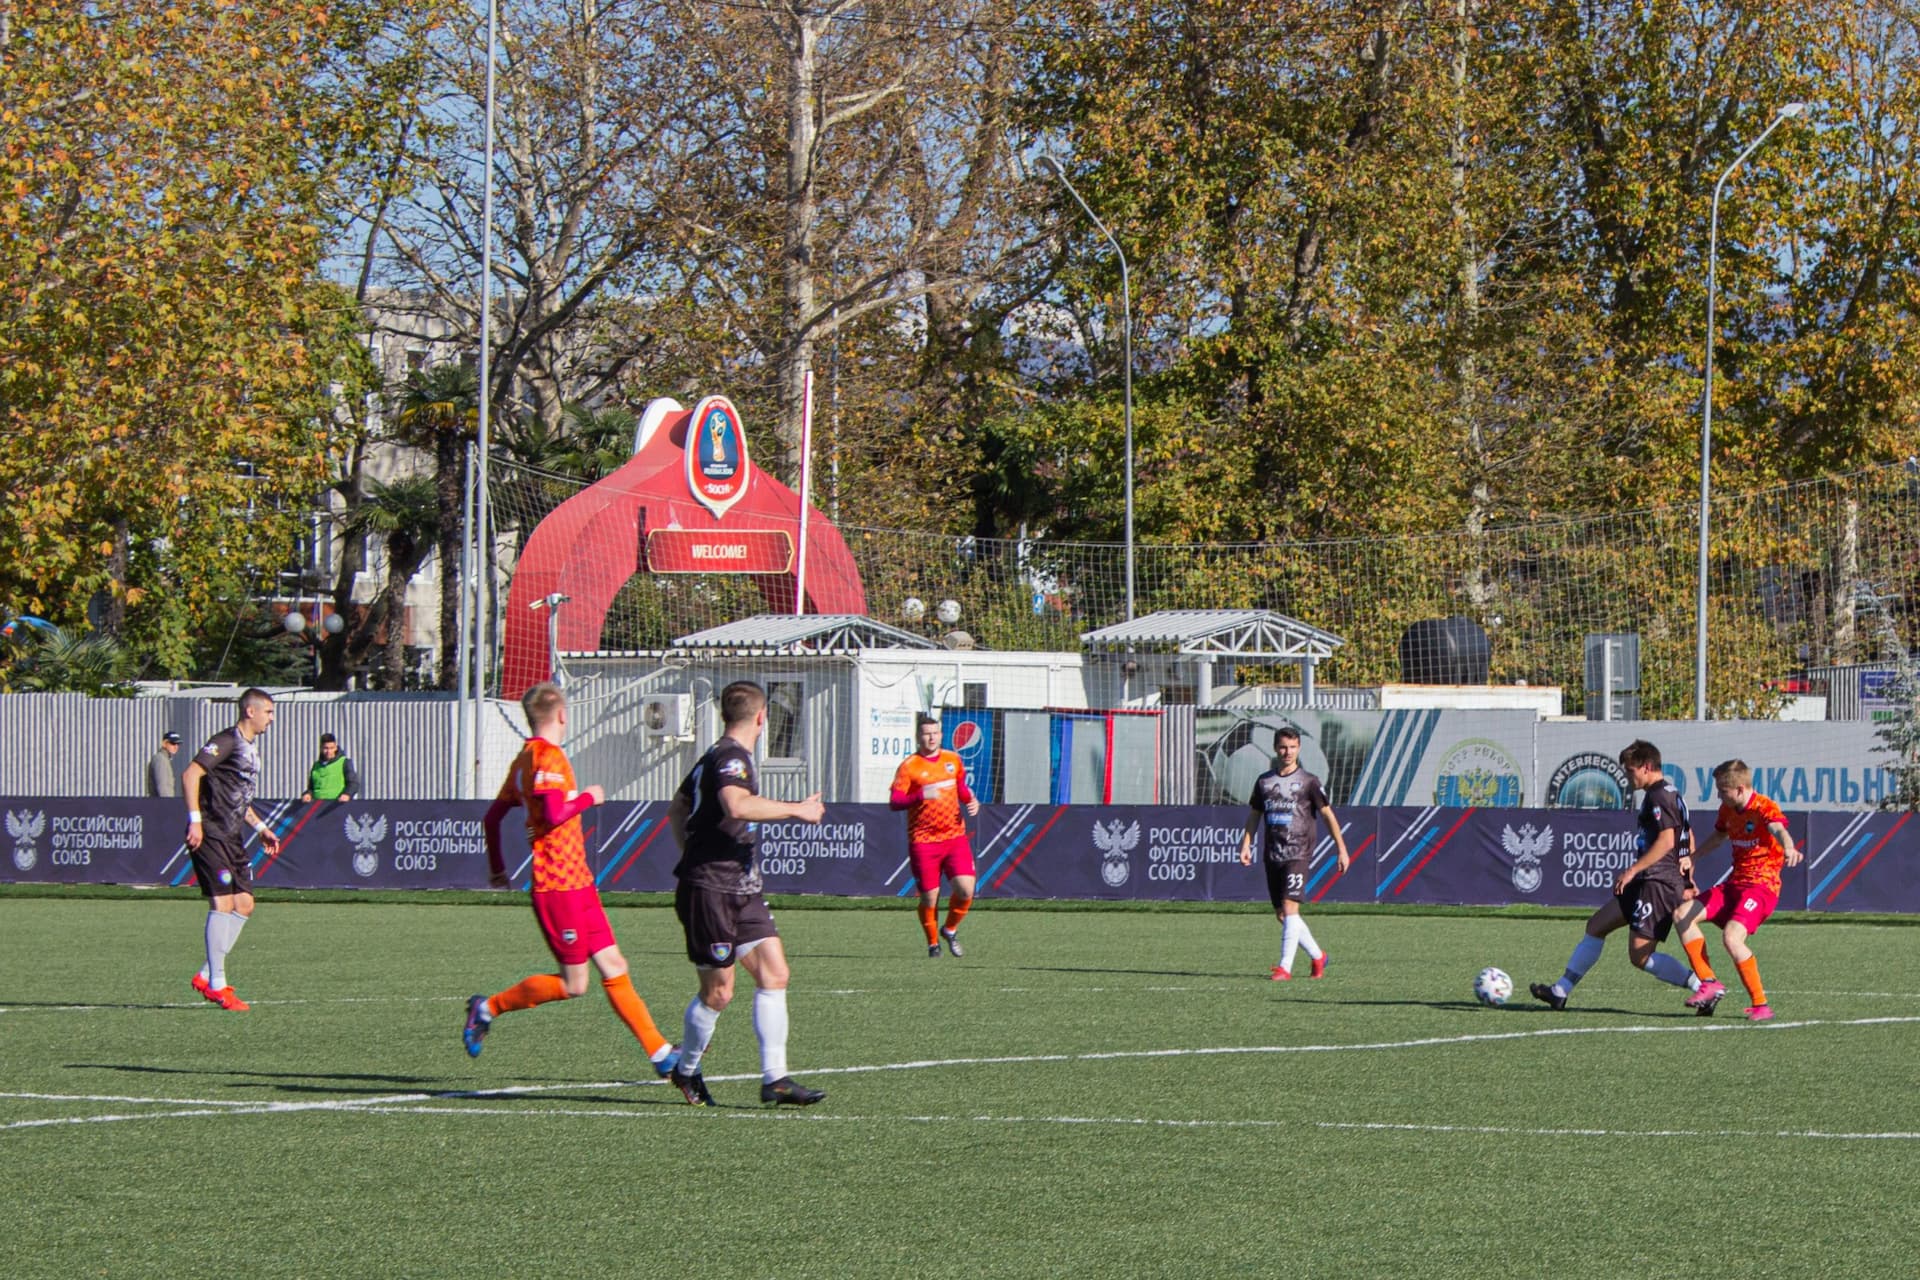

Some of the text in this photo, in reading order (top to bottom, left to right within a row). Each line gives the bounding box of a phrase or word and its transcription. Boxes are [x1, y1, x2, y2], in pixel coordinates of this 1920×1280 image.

[692, 544, 747, 559] WELCOME!
[871, 737, 912, 759] ВХОД
[1552, 755, 1629, 788] INTERRECORD
[52, 815, 143, 832] РОССИЙСКИЙ
[52, 832, 143, 849] ФУТБОЛЬНЫЙ
[761, 840, 864, 858] ФУТБОЛЬНЫЙ
[52, 850, 91, 865] СОЮЗ
[395, 855, 437, 870] СОЮЗ
[761, 858, 806, 874] СОЮЗ
[1148, 864, 1196, 881] СОЮЗ
[1287, 873, 1304, 889] 33
[1562, 870, 1613, 888] СОЮЗ
[1633, 899, 1653, 920] 29
